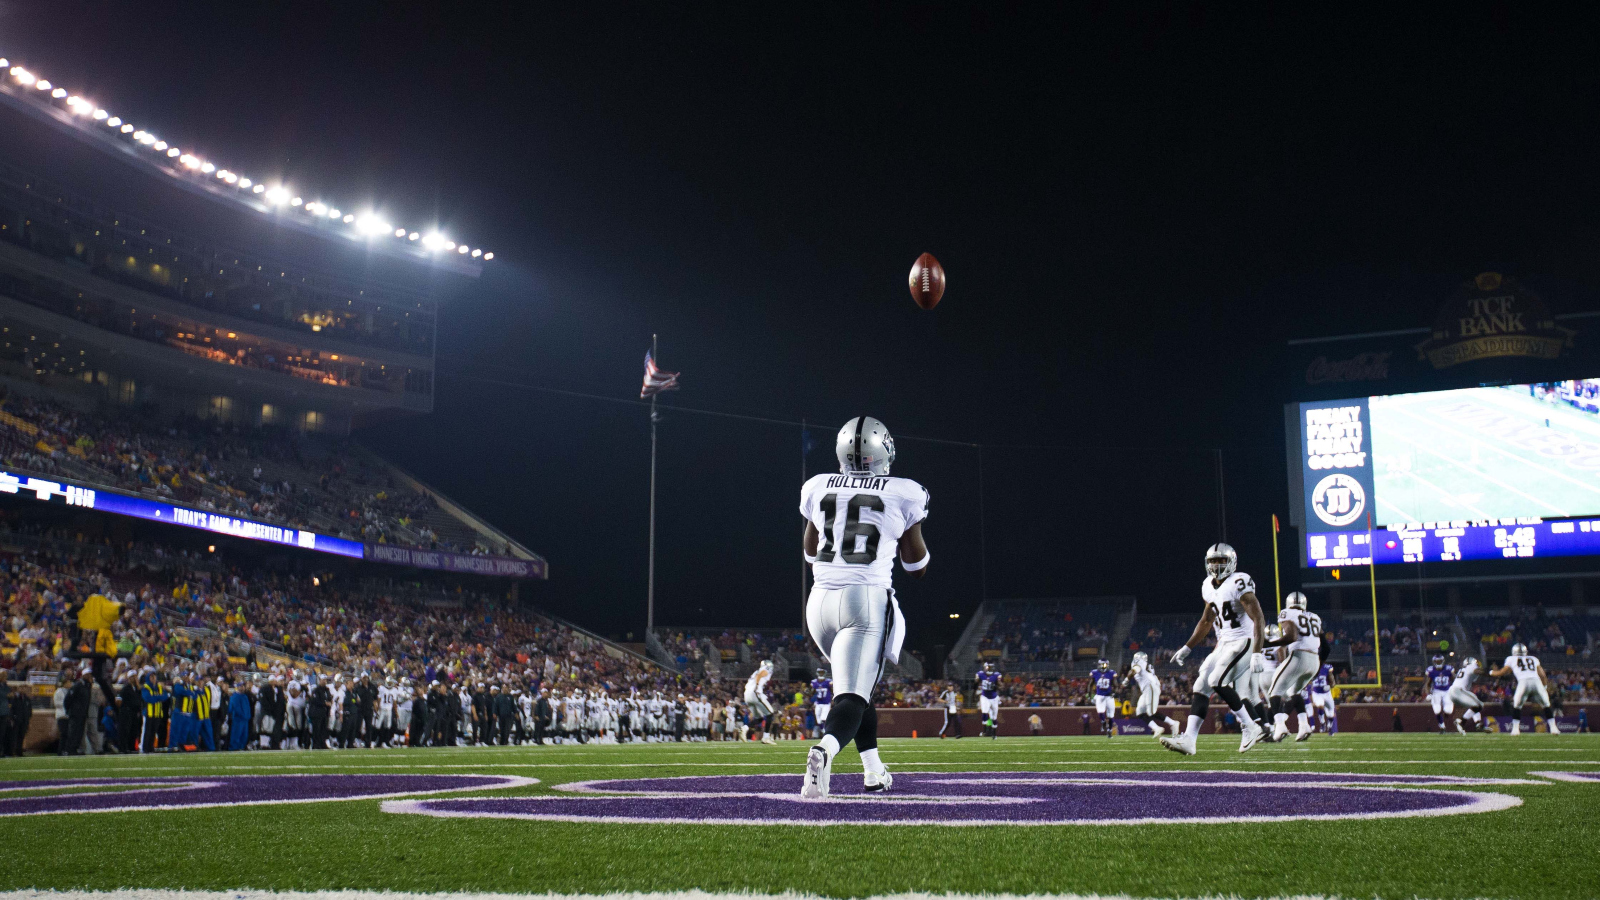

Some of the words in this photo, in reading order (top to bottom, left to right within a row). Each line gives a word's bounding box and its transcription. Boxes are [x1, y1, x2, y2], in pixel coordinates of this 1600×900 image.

[1467, 295, 1515, 317] TCF
[1458, 313, 1527, 337] BANK
[1442, 336, 1547, 365] STADIUM
[826, 475, 890, 491] HOLLIDAY
[174, 508, 207, 527] TODAY'S
[815, 493, 885, 565] 16
[373, 544, 410, 564] MINNESOTA
[411, 551, 440, 567] VIKINGS
[453, 557, 493, 572] MINNESOTA
[495, 561, 528, 574] VIKINGS
[1298, 615, 1321, 638] 96
[1516, 657, 1536, 672] 48
